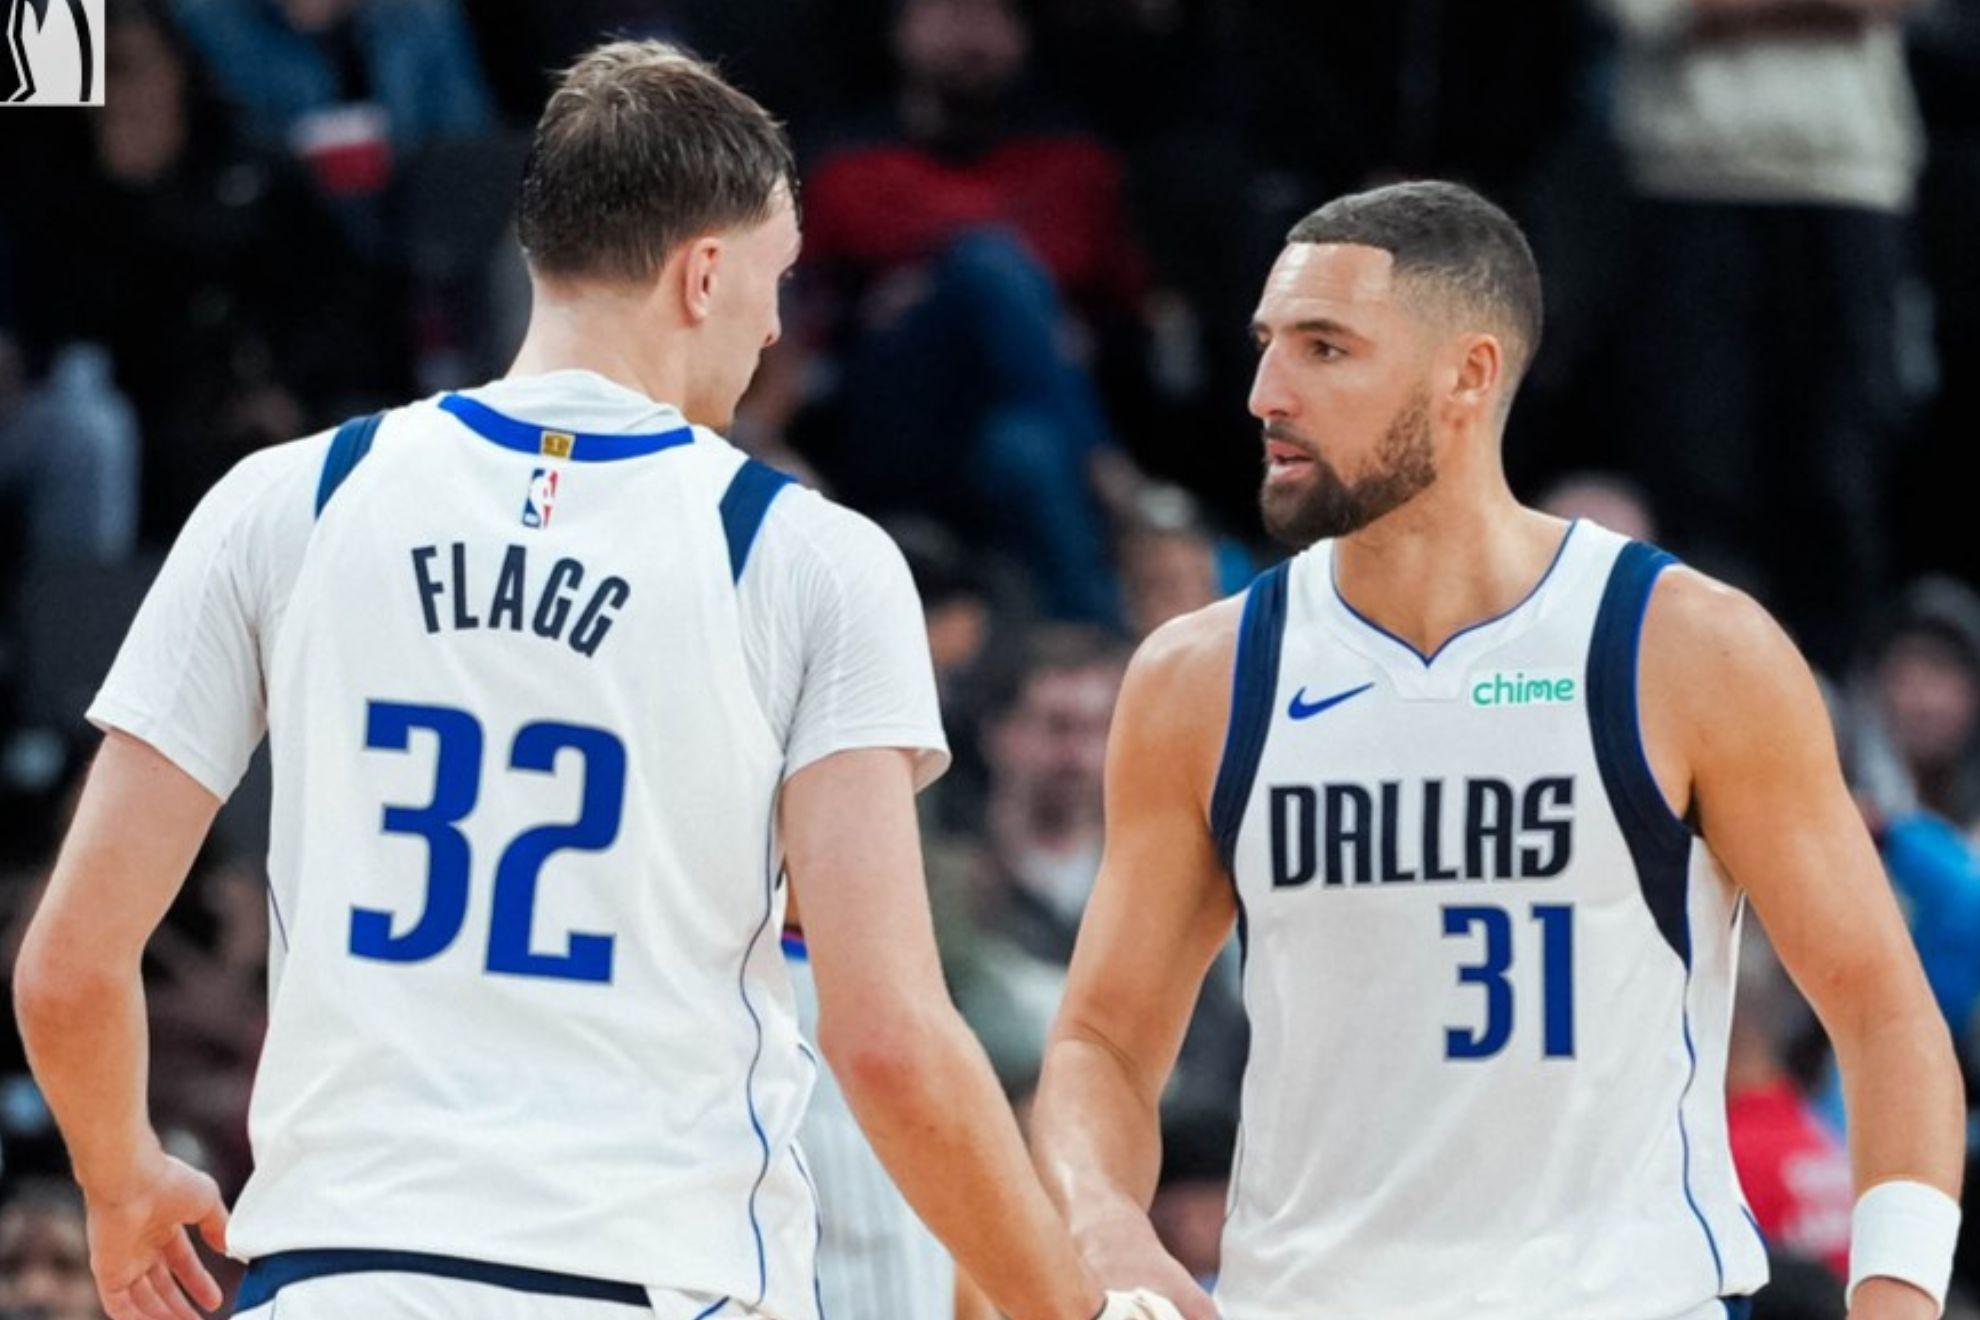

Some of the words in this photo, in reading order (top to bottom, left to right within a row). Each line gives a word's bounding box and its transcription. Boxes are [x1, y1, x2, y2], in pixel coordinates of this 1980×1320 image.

[412, 543, 630, 658] FLAGG
[1473, 673, 1575, 706] chime
[348, 699, 627, 985] 32
[1269, 776, 1575, 889] DALLAS
[1440, 903, 1576, 1061] 31
